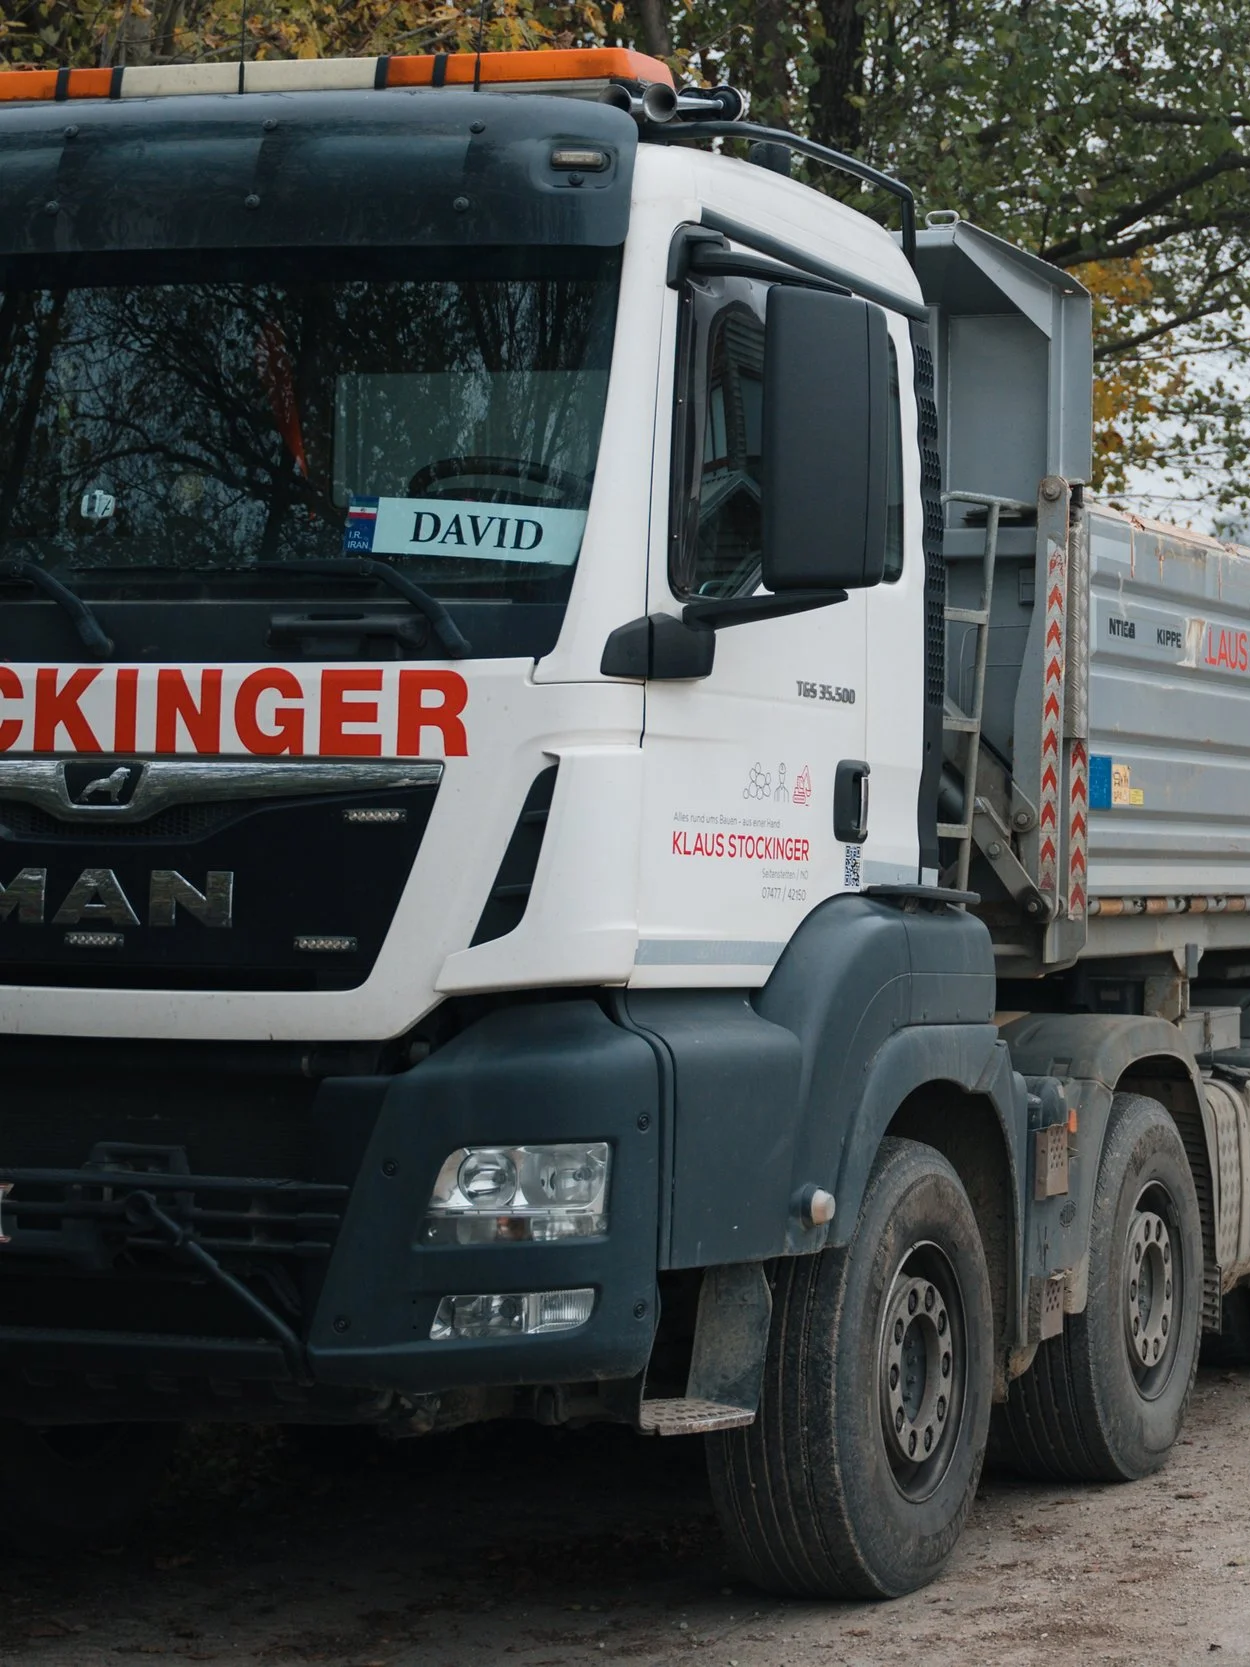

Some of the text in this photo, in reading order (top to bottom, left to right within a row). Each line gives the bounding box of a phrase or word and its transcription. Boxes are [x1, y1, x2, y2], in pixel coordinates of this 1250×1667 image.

[409, 511, 544, 550] DAVID
[347, 540, 369, 550] IRAN
[1157, 628, 1182, 648] KIPPE
[1205, 626, 1248, 672] LAUS
[796, 680, 856, 704] TGS 35.500
[672, 831, 809, 861] KLAUS STOCKINGER
